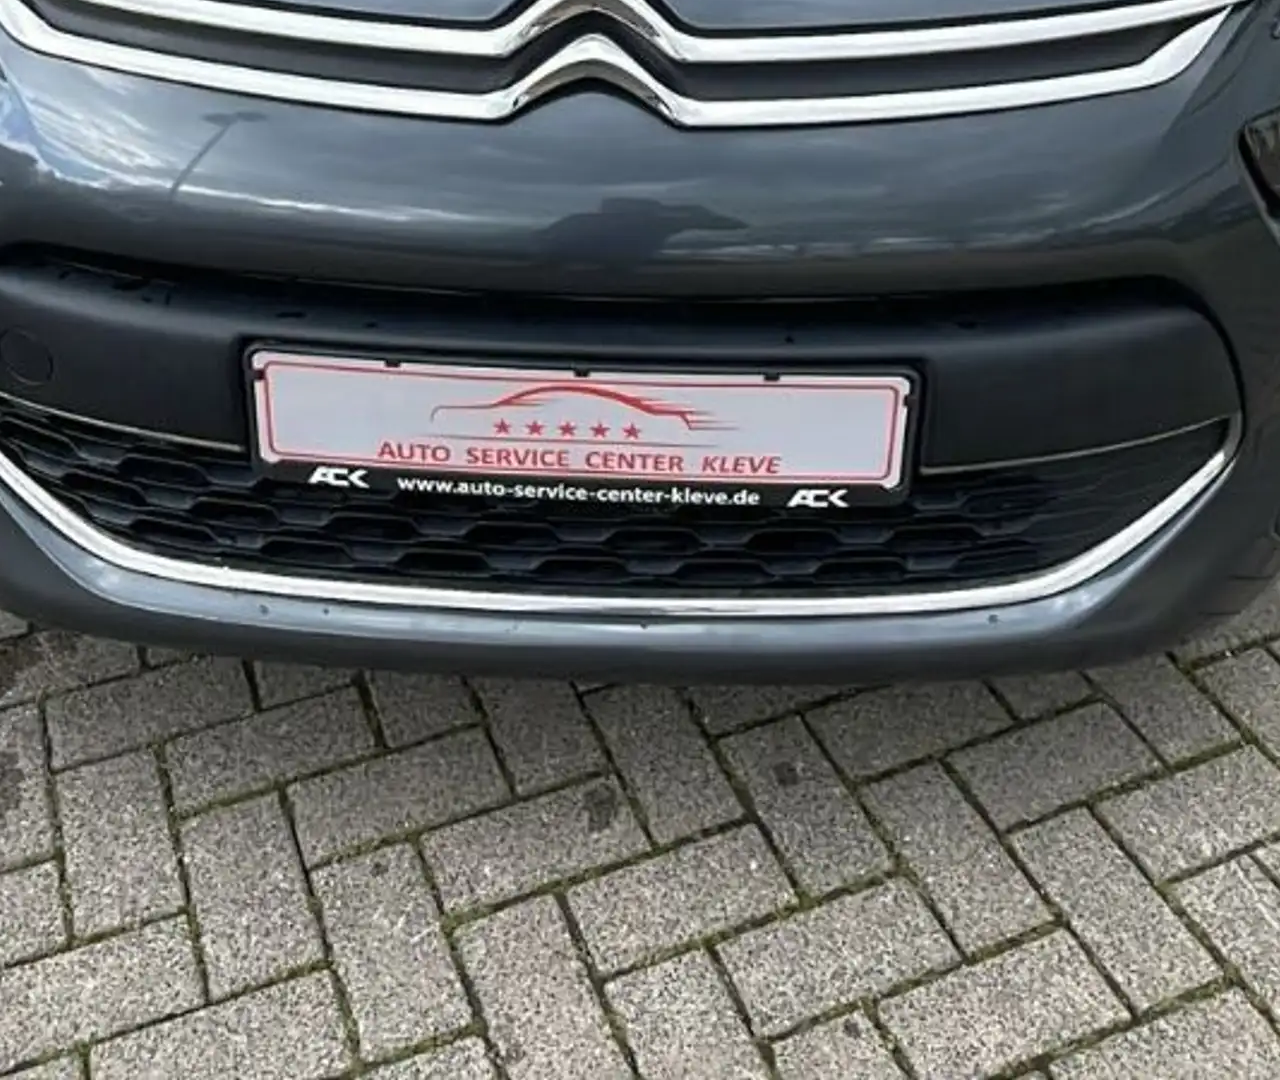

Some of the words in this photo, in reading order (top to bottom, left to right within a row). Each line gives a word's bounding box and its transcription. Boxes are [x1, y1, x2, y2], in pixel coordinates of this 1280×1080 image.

[377, 441, 451, 463] AUTO
[466, 446, 569, 468] SERVICE
[585, 451, 684, 473] CENTER
[701, 456, 782, 475] KLEVE
[396, 477, 760, 505] www.auto-service-center-kleve.de
